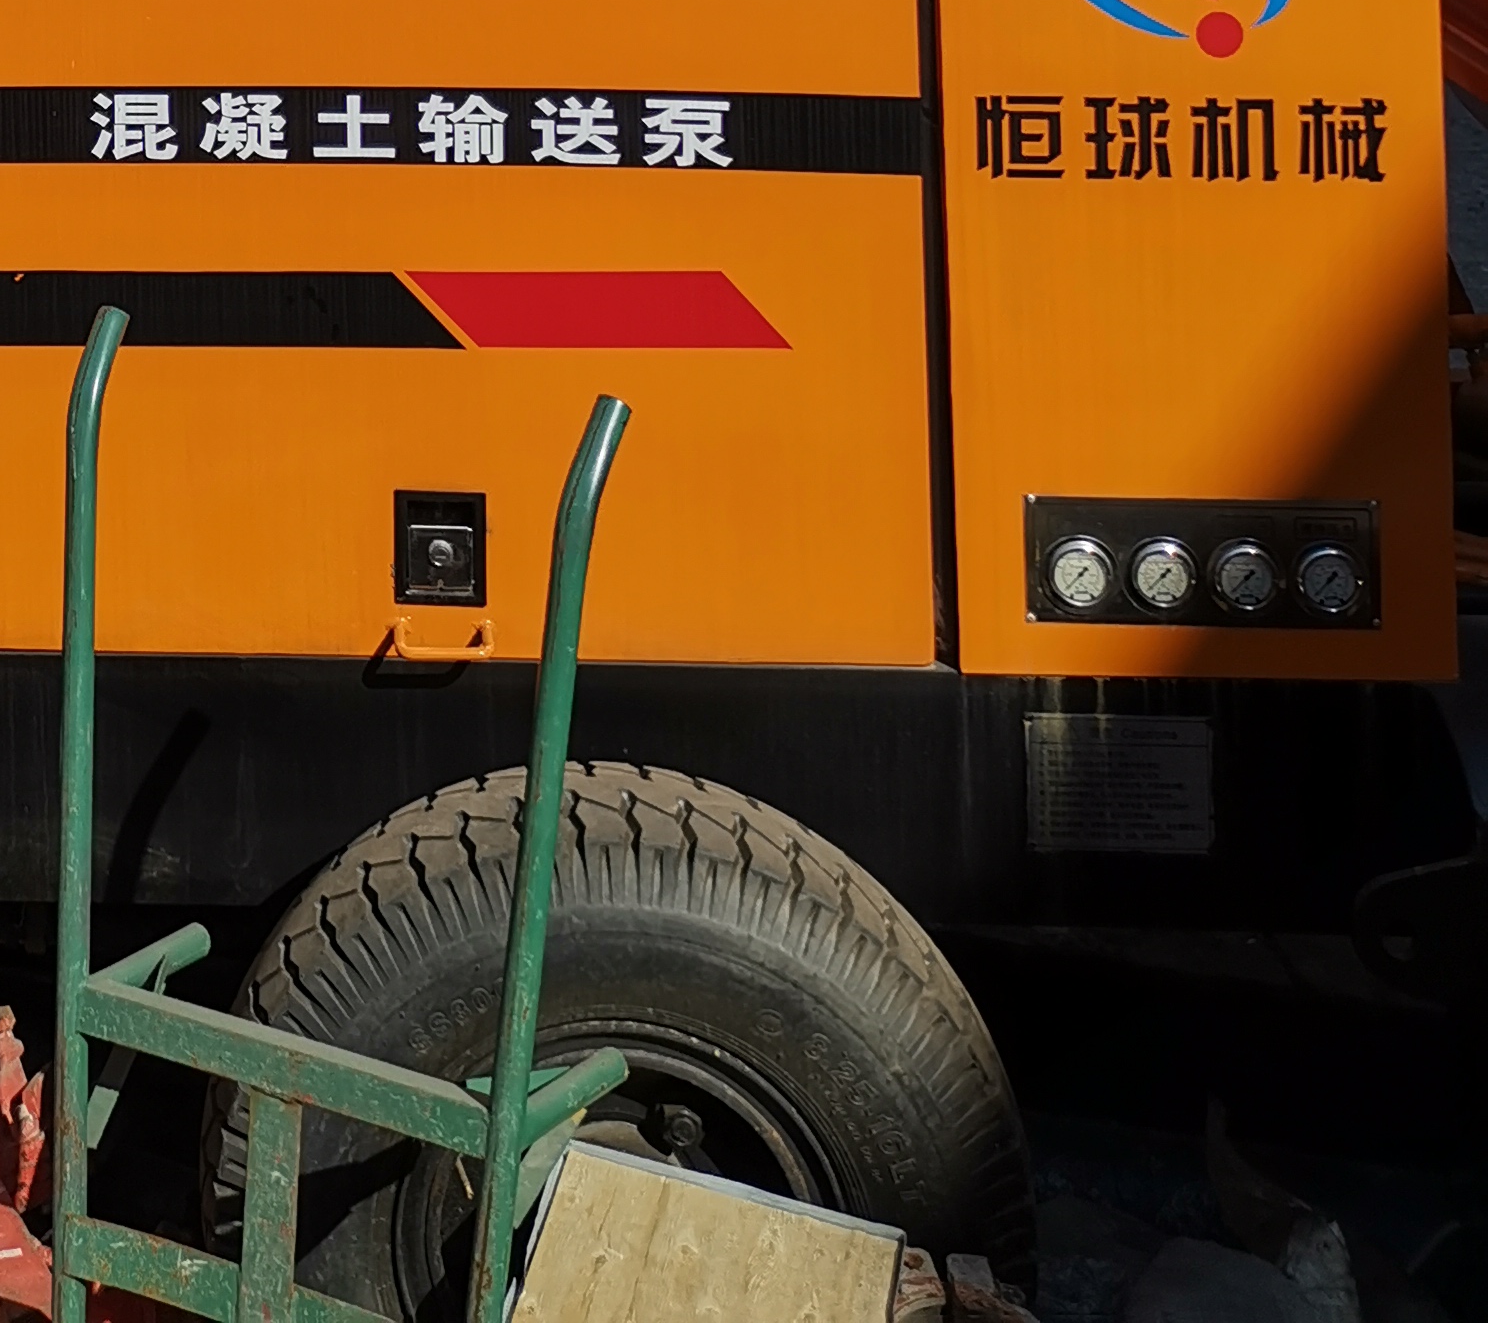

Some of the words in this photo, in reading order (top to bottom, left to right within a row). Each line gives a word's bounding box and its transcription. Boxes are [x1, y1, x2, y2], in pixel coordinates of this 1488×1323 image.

[89, 91, 733, 168] 混凝土输送泵
[975, 94, 1388, 182] 恒球机械
